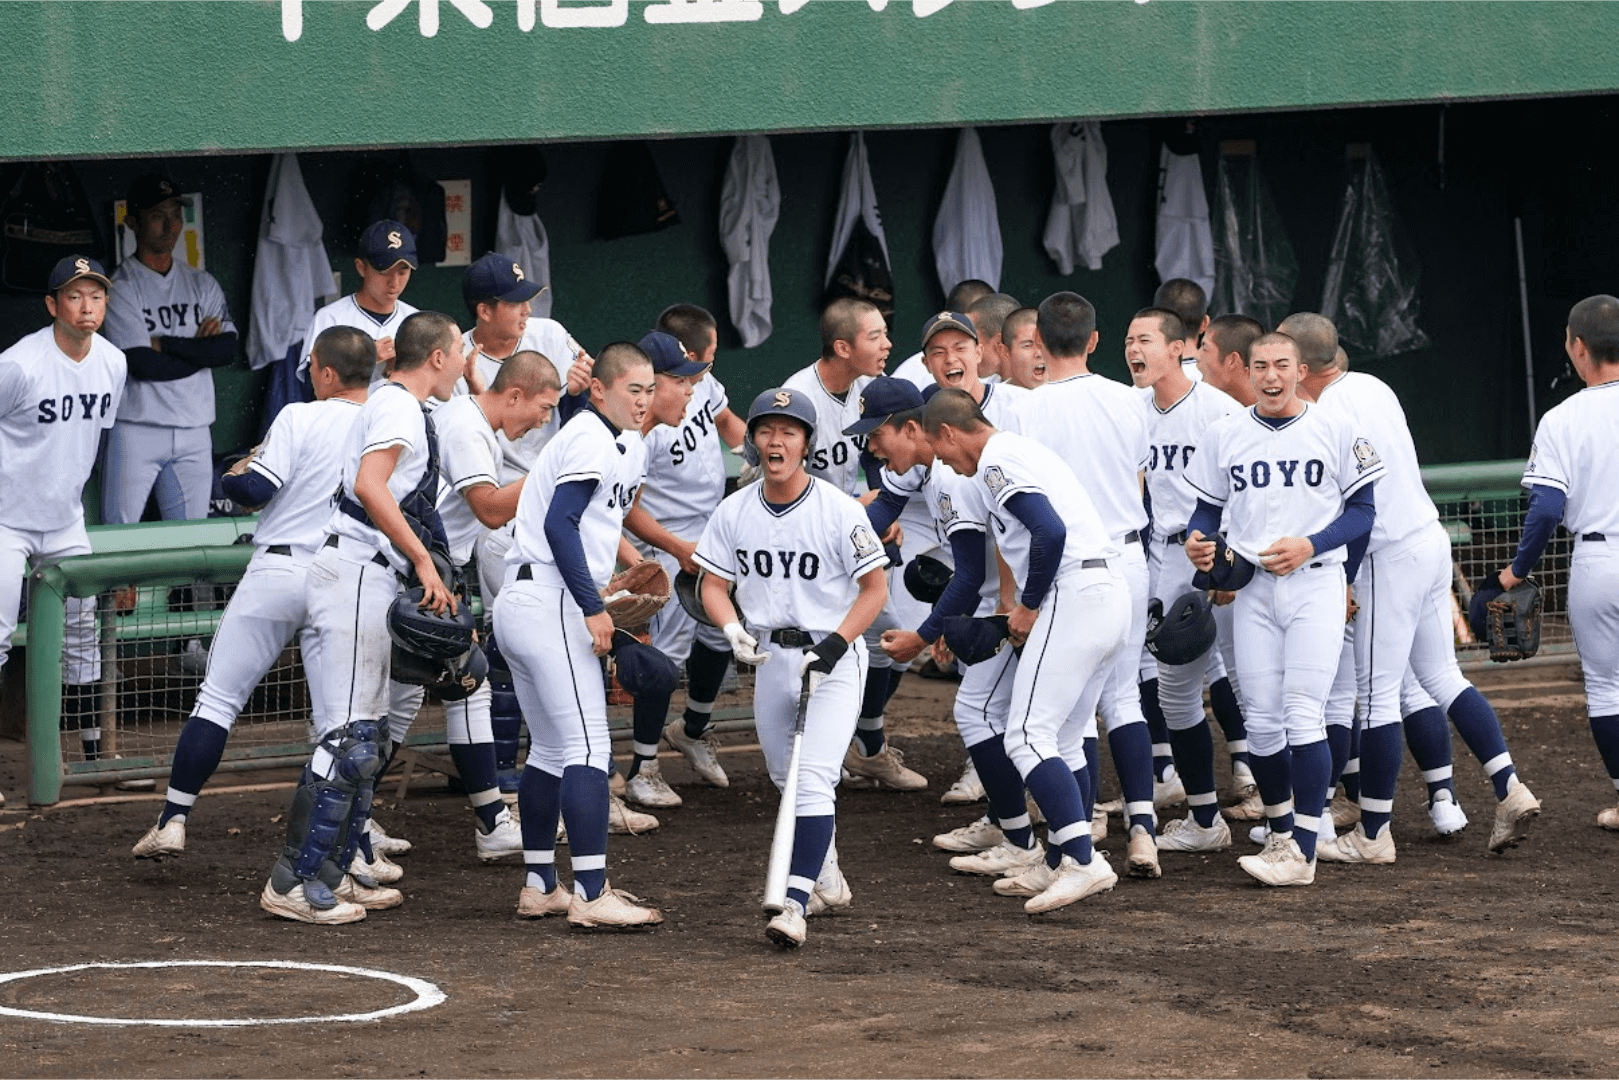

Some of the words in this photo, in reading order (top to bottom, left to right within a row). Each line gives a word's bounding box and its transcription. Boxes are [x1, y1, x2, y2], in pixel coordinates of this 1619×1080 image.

[387, 231, 403, 250] S
[75, 258, 91, 275] S
[512, 263, 525, 283] S
[774, 392, 791, 408] S
[1230, 459, 1325, 493] SOYO
[736, 549, 820, 581] SOYO
